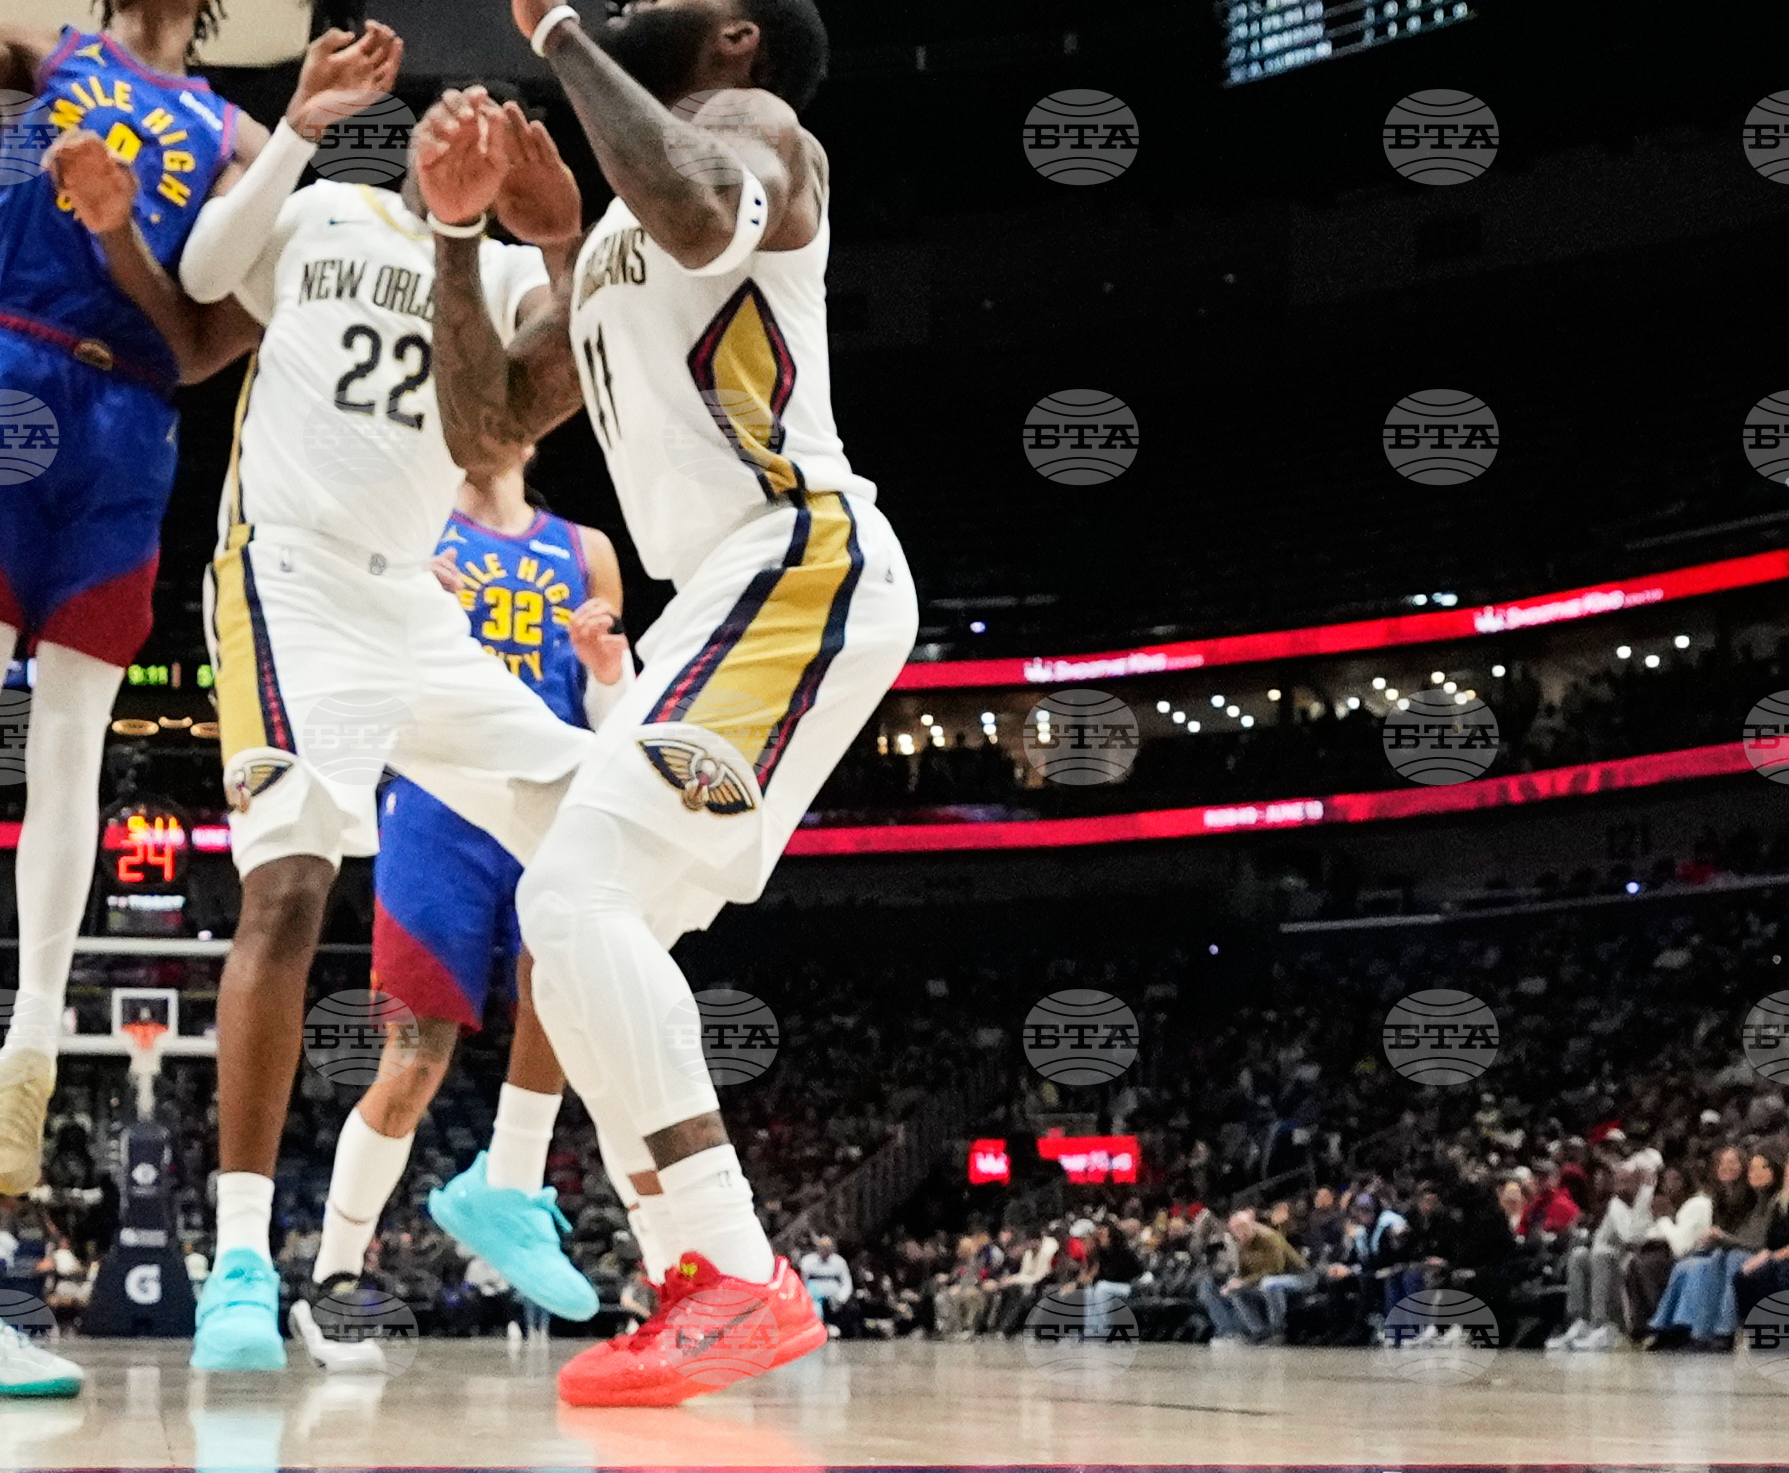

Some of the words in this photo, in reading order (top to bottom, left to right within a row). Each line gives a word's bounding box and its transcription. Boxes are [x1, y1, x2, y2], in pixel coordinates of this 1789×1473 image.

[47, 76, 135, 130] MILE
[141, 107, 196, 207] HIGH
[299, 259, 367, 306] NEW
[372, 265, 435, 323] ORLE
[334, 324, 433, 430] 22
[456, 552, 508, 612] MILE
[516, 556, 574, 626] HIGH
[481, 586, 544, 646] 32
[118, 839, 176, 883] 24
[125, 1263, 161, 1304] G
